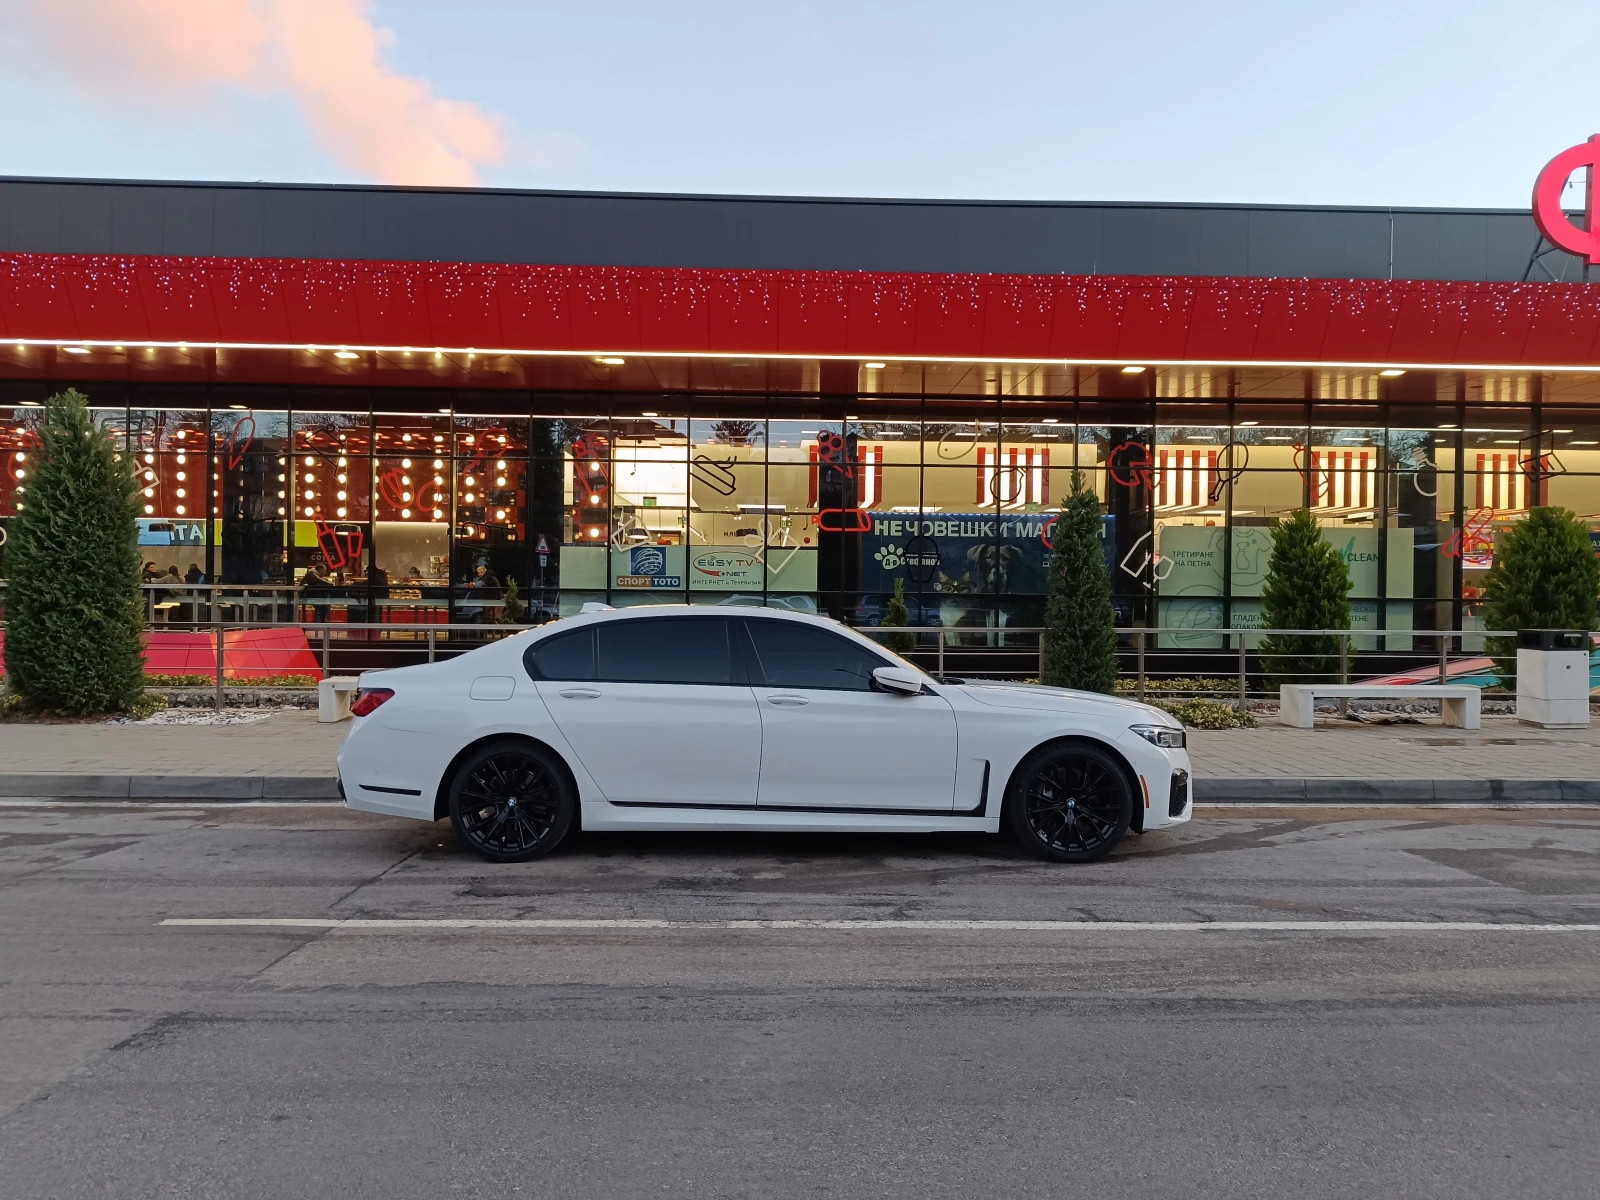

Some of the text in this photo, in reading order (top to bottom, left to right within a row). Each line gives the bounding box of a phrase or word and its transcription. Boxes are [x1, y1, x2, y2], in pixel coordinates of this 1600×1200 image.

[1015, 522, 1107, 538] МАГН
[310, 554, 336, 562] COSA
[1346, 553, 1382, 562] CLEAN
[735, 559, 754, 567] TV
[617, 578, 679, 586] СПОРТ ТОТО
